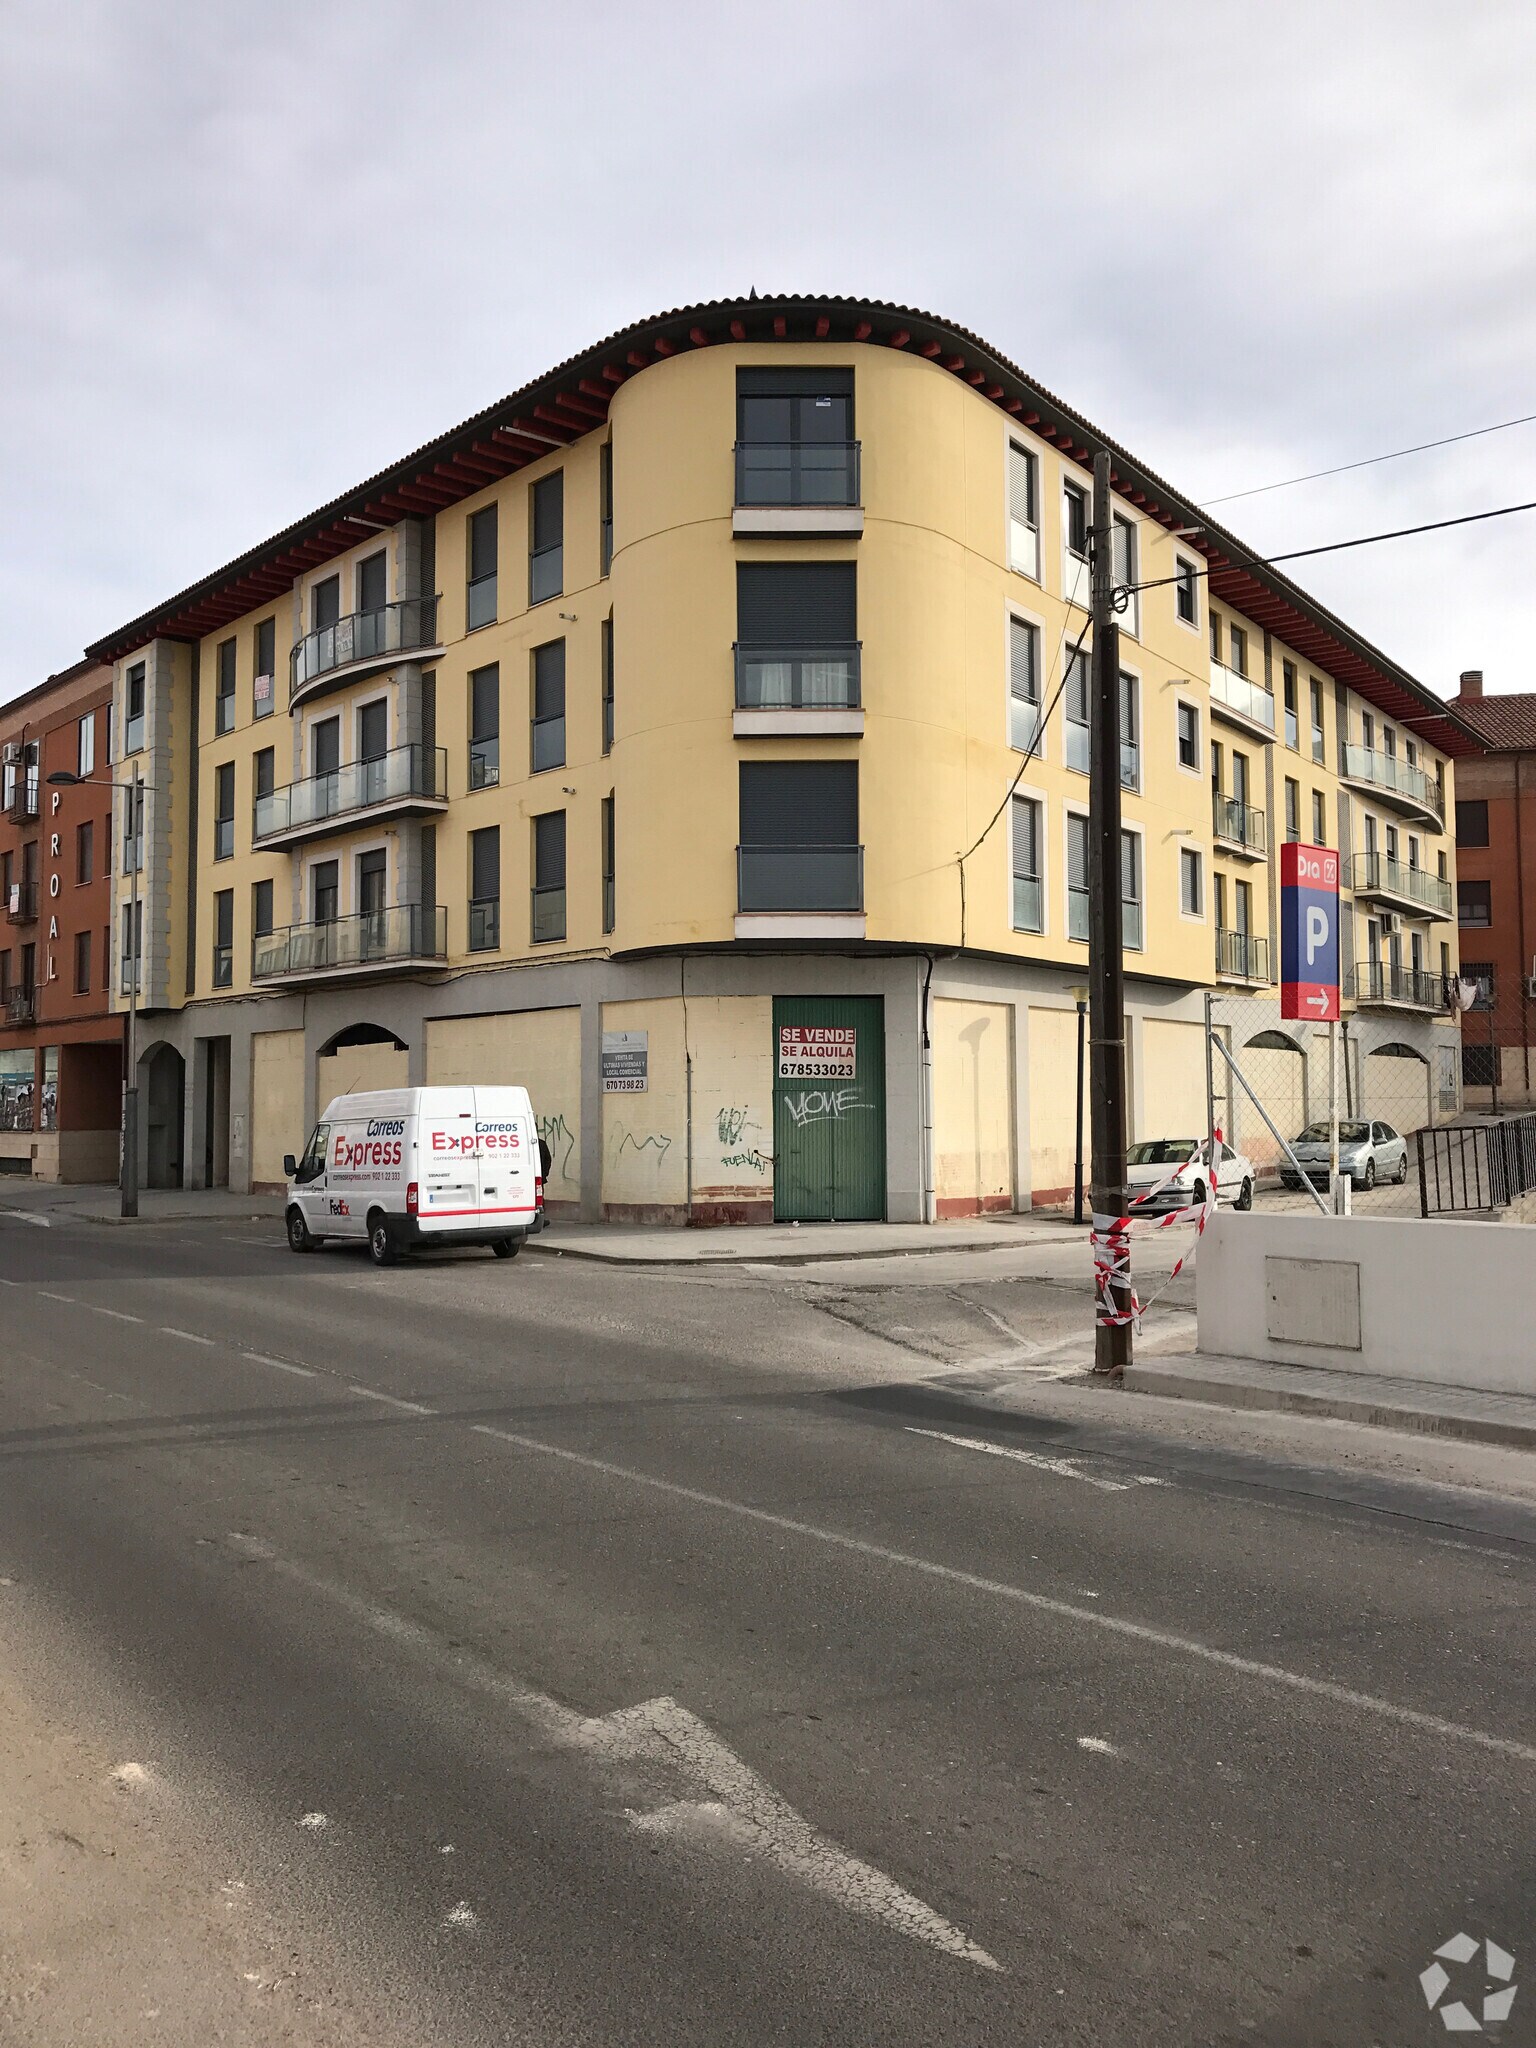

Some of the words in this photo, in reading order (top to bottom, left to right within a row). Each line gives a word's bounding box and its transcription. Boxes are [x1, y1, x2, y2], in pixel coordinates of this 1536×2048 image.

[49, 791, 60, 980] PROAL
[1307, 906, 1329, 966] P
[781, 1028, 801, 1042] SE
[804, 1029, 854, 1043] VENDE
[781, 1046, 797, 1057] SE
[800, 1046, 854, 1058] ALQUILA
[780, 1063, 853, 1076] 678533023
[367, 1119, 405, 1136] Correos
[475, 1122, 518, 1133] Correos
[432, 1132, 520, 1154] Express
[334, 1135, 402, 1171] Express
[391, 1172, 401, 1180] 333
[330, 1199, 350, 1216] FedEx
